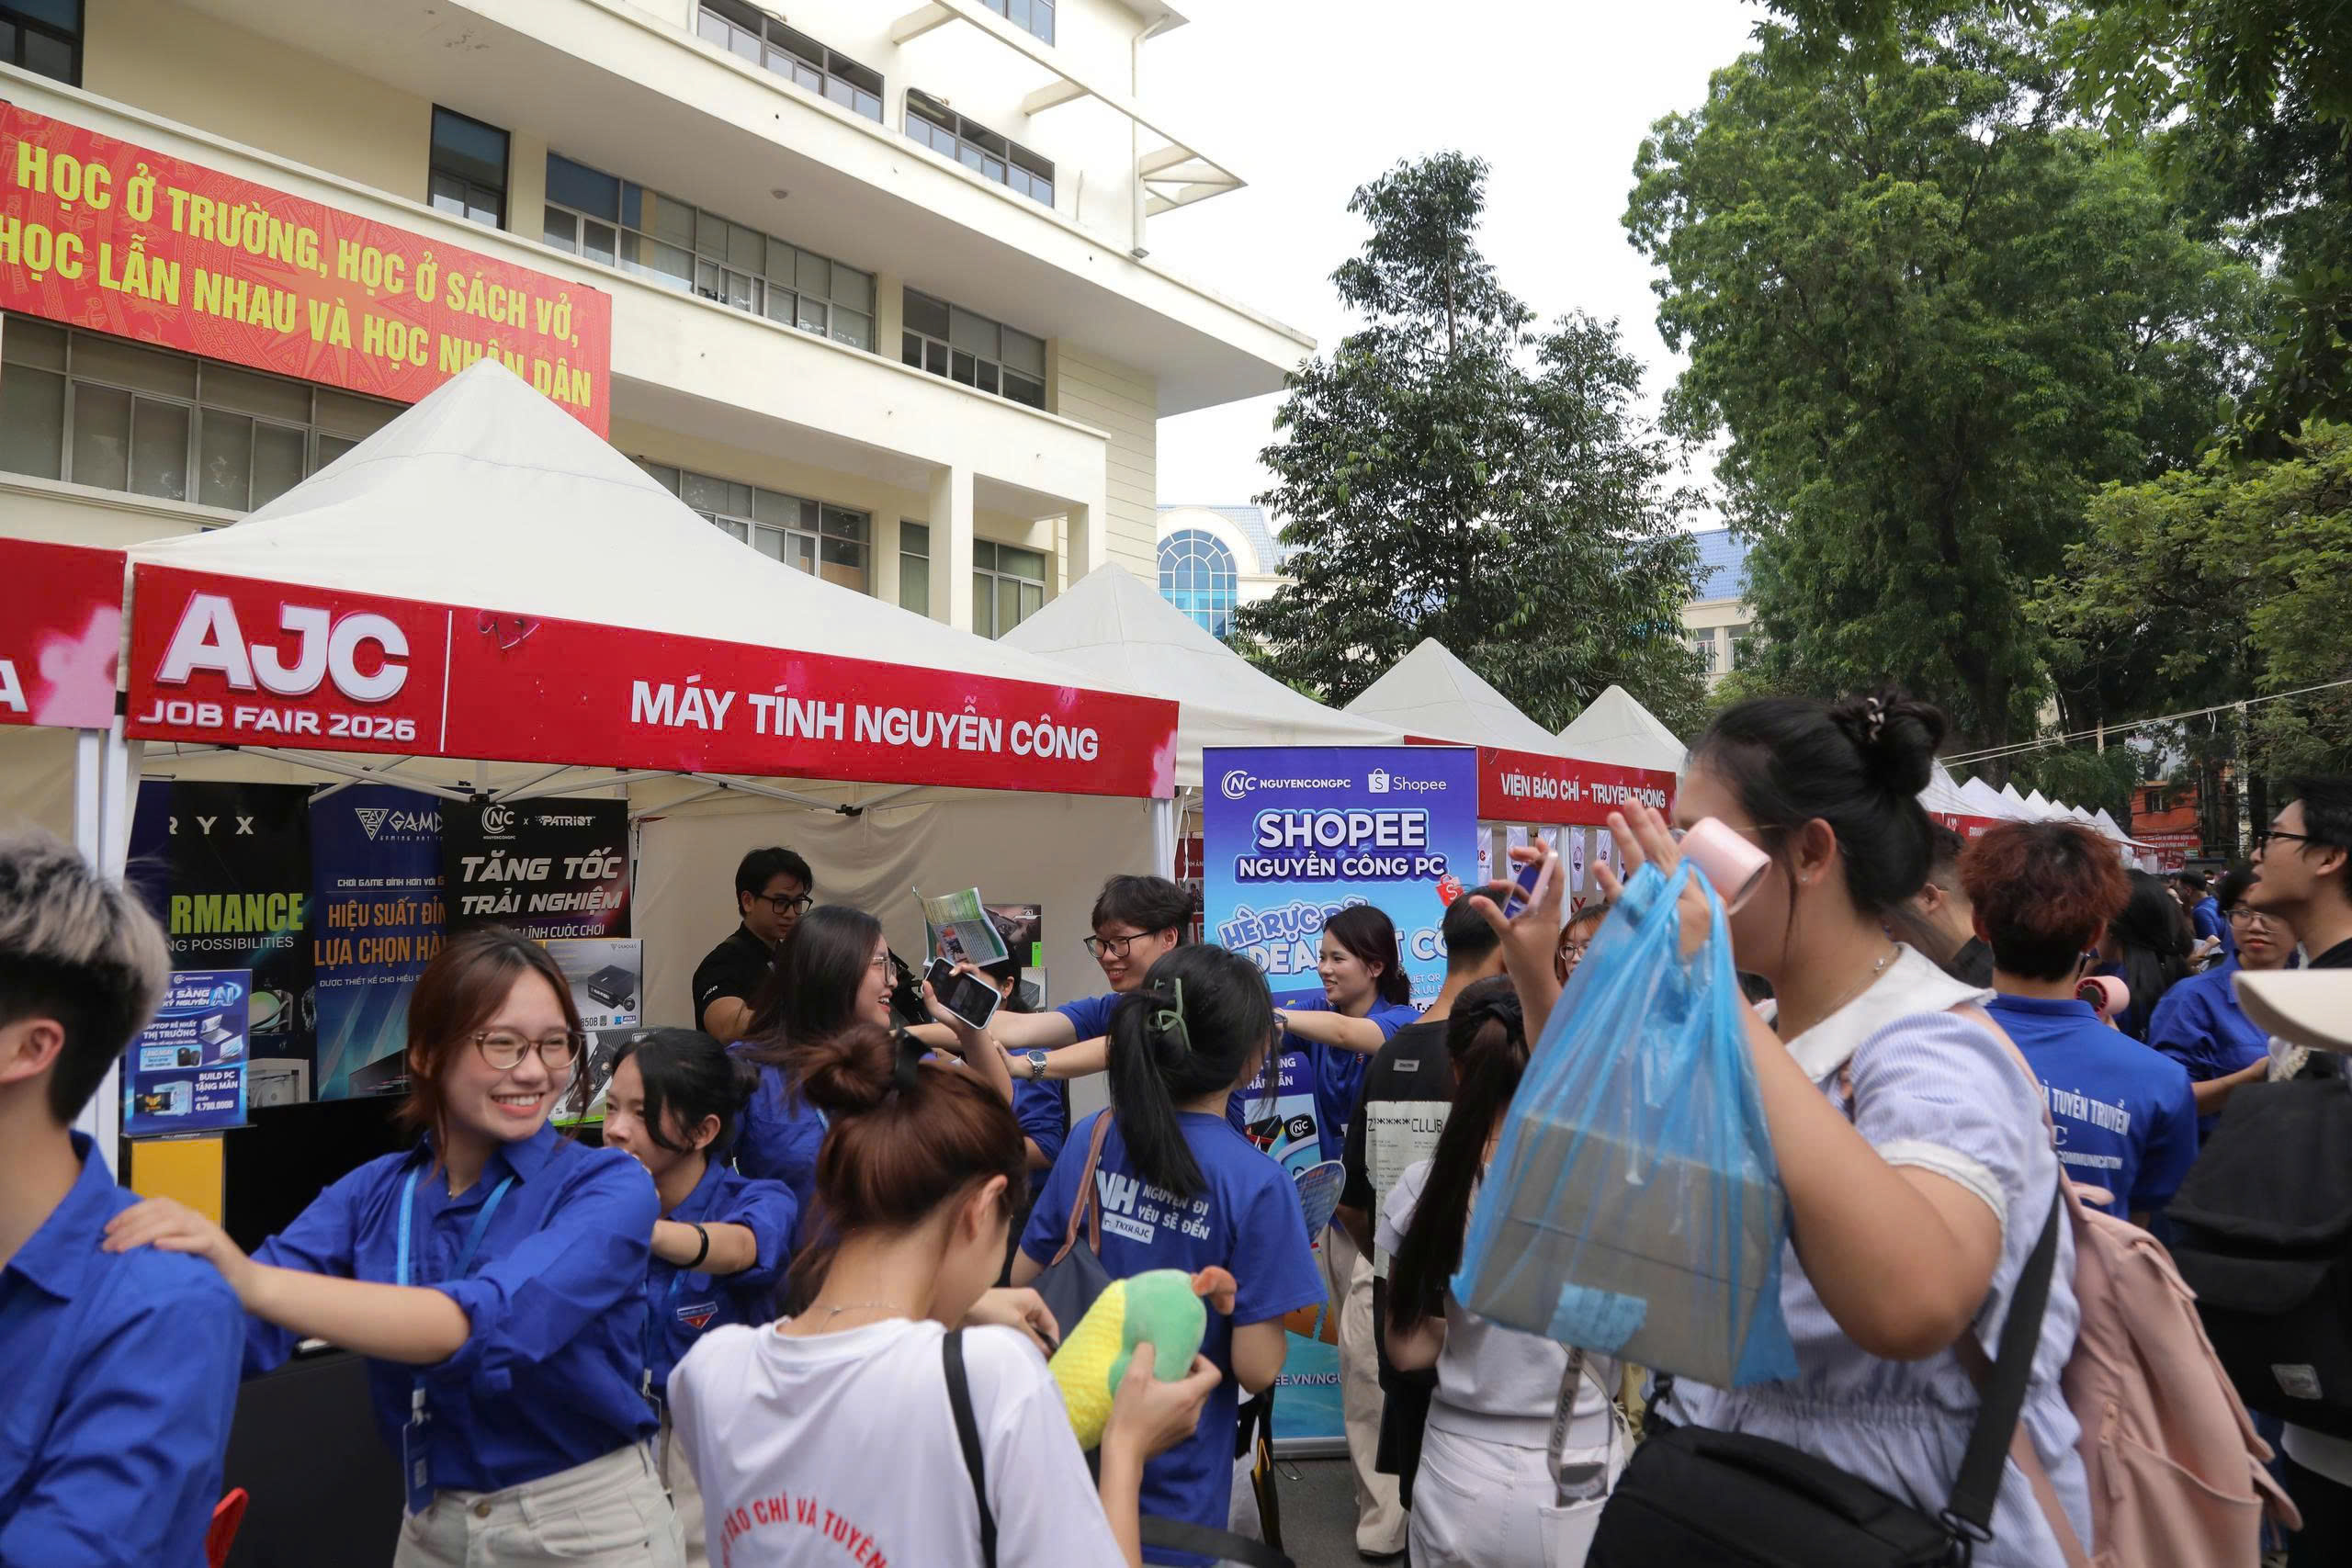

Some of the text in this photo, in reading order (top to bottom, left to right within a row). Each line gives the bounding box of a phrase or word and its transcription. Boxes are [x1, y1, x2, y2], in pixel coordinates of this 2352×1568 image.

[17, 141, 580, 348] HỌC Ở TRƯỜNG, HỌC Ở SÁCH VỞ,
[0, 214, 84, 282] HỌC
[98, 233, 181, 306] LẪN
[194, 268, 296, 334] NHAU
[308, 297, 353, 349] VÀ
[363, 313, 429, 371] HỌC
[533, 358, 592, 408] DÂN
[154, 589, 411, 704] AJC
[139, 700, 416, 742] JOB FAIR 2026
[630, 673, 1099, 761] MÁY TÍNH NGUYỄN CÔNG
[1260, 779, 1351, 789] NGUYENCONGPC
[1393, 776, 1447, 794] Shopee
[1500, 768, 1531, 802] VIỆN
[1532, 772, 1558, 800] BÁO
[1560, 775, 1579, 802] CHÍ
[1258, 813, 1425, 848] SHOPEE
[461, 847, 622, 883] TĂNG TỐC
[1239, 851, 1446, 877] NGUYỄN CÔNG PC
[337, 879, 356, 887] CHƠI
[358, 878, 384, 886] GAME
[170, 892, 304, 934] RMANCE
[328, 899, 369, 931] HIỆU
[374, 896, 418, 928] SUẤT
[461, 886, 623, 916] TRẢI NGHIỆM
[550, 923, 580, 940] CUỘC
[1222, 907, 1258, 947] HÈ
[1261, 903, 1318, 941] RỰC
[191, 936, 294, 951] POSSIBILITIES
[314, 931, 447, 970] LỰA CHỌN HÀ
[176, 987, 210, 998] SÀNG
[379, 976, 395, 984] CHO
[210, 986, 234, 1007] AI
[147, 1022, 169, 1031] APTOP
[198, 1072, 222, 1081] BUILD
[219, 1079, 238, 1089] MÀN
[2052, 1088, 2088, 1122] TUYÊN
[1411, 1118, 1443, 1134] CLUB
[1137, 1204, 1211, 1240] YÊU SẼ ĐẾN
[1193, 1201, 1209, 1216] ĐI
[752, 1489, 789, 1526] CHÍ
